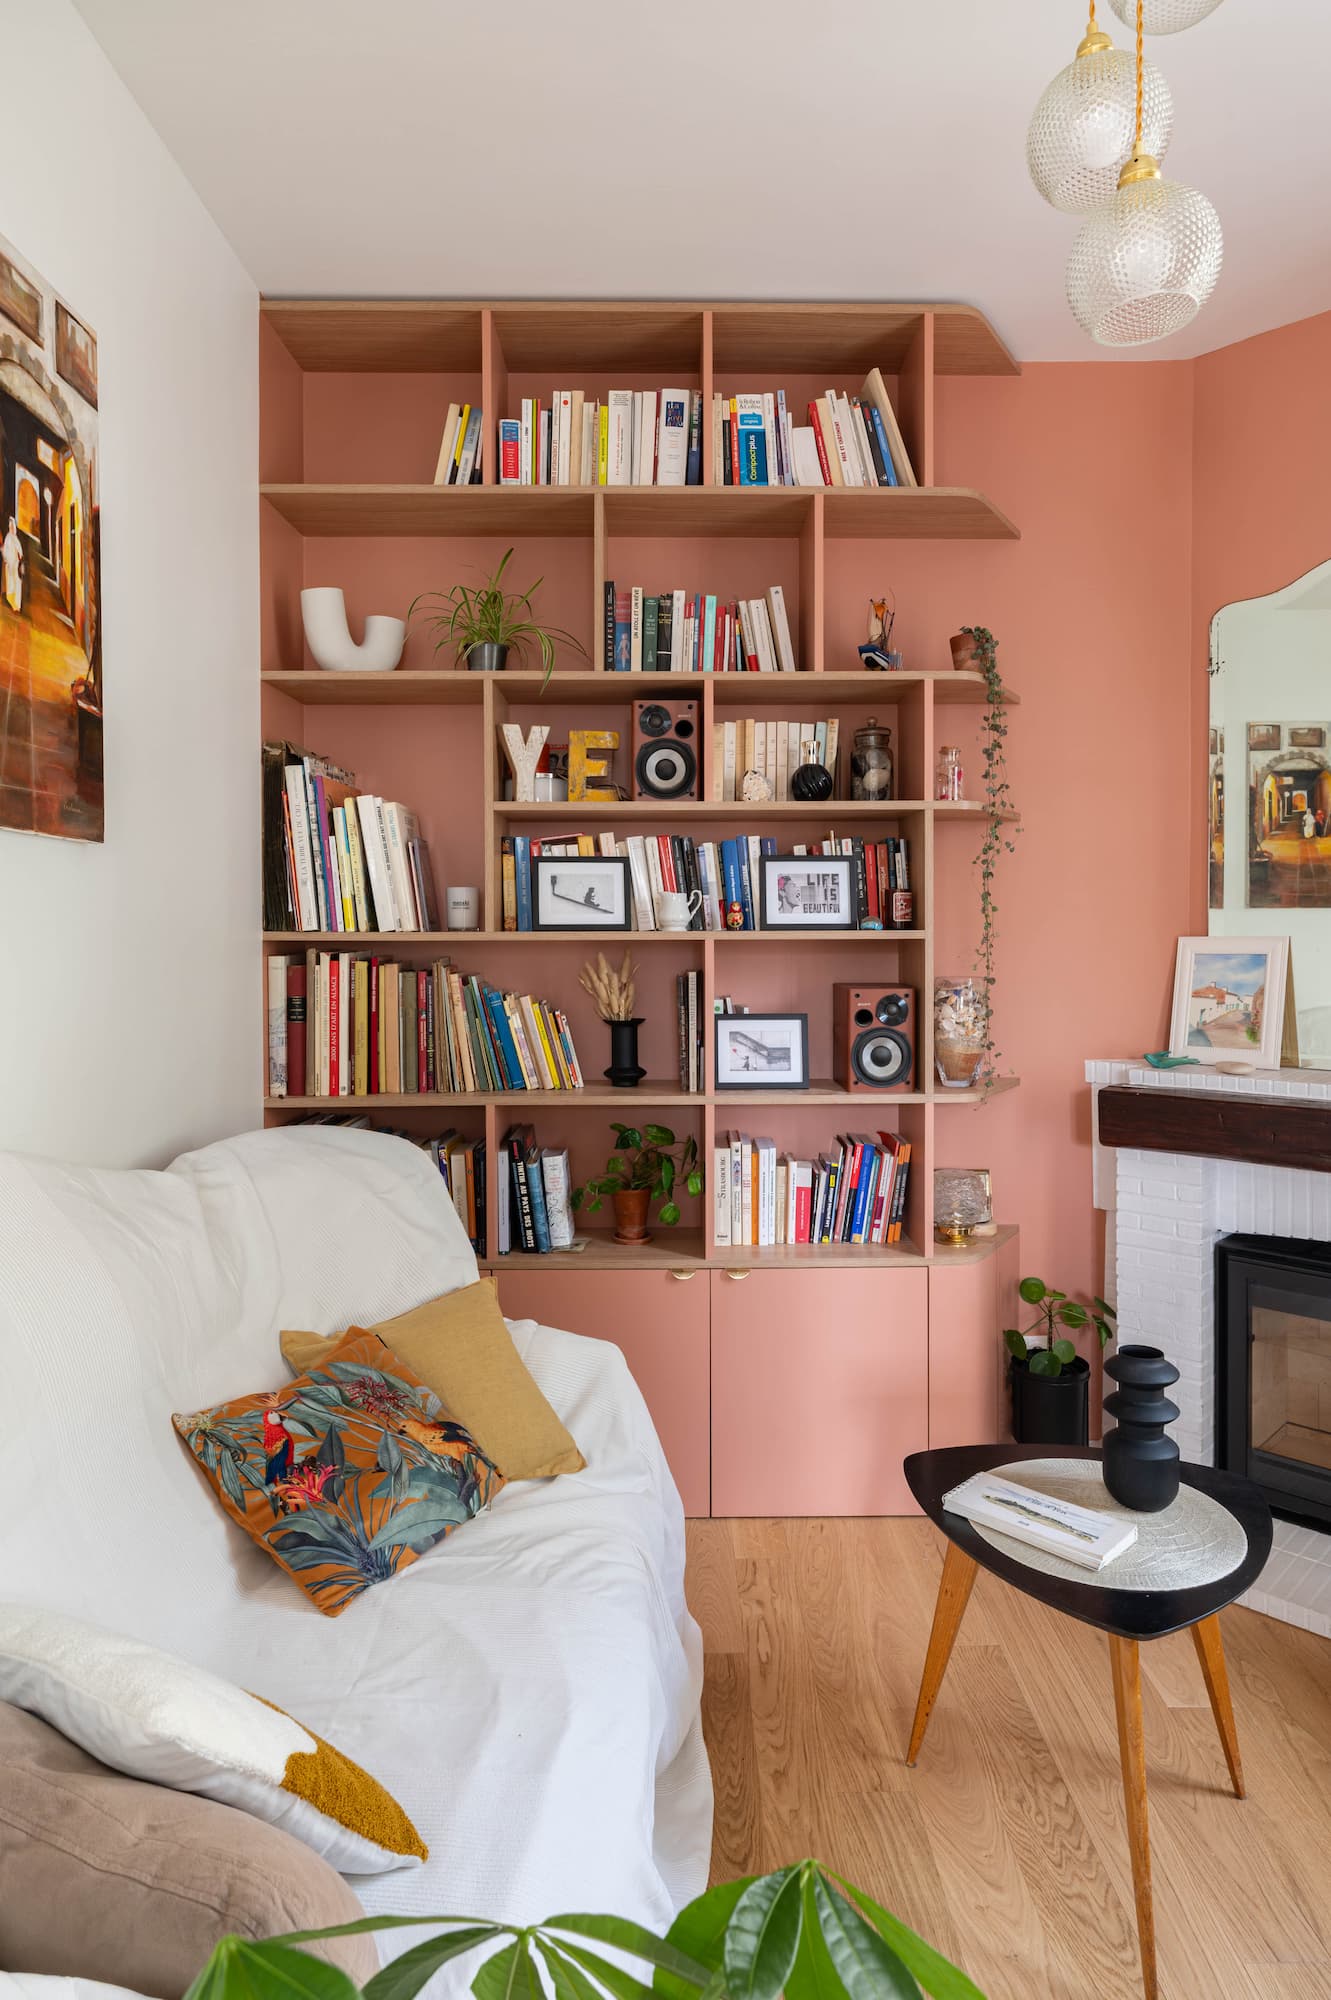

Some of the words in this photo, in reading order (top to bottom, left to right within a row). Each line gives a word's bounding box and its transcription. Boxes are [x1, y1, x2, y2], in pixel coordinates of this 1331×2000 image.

[633, 602, 640, 610] UN
[807, 874, 839, 886] LIFE
[824, 888, 837, 900] IS
[331, 1000, 337, 1010] EN
[517, 1161, 527, 1183] TINTIN
[519, 1185, 527, 1195] AU
[521, 1196, 530, 1213] PAYS
[523, 1215, 532, 1227] DES
[526, 1230, 535, 1248] MOTS
